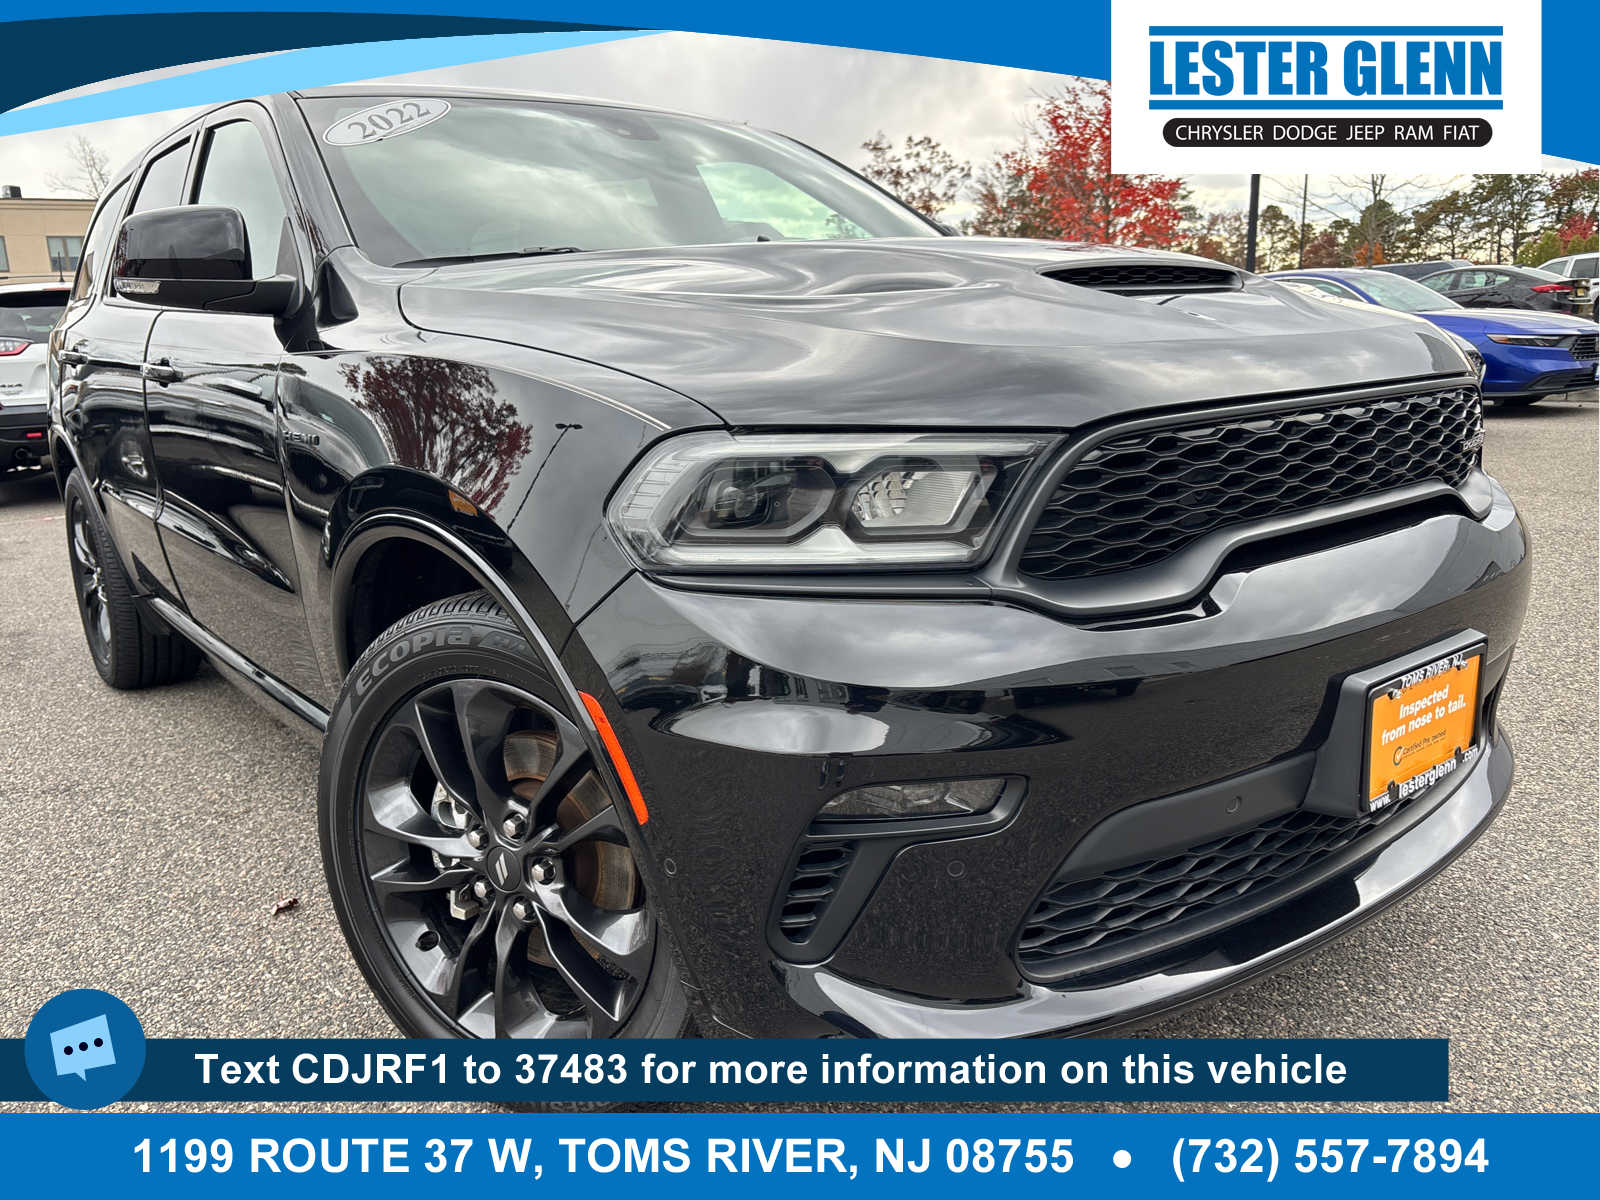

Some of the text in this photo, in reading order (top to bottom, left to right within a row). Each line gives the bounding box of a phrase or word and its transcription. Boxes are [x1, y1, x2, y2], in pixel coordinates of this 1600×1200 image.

[347, 102, 431, 139] 2022
[1401, 669, 1425, 689] TOMS
[1399, 683, 1450, 719] Inspected
[1381, 694, 1466, 746] from nose to tail.
[1399, 759, 1456, 798] lesterglenn
